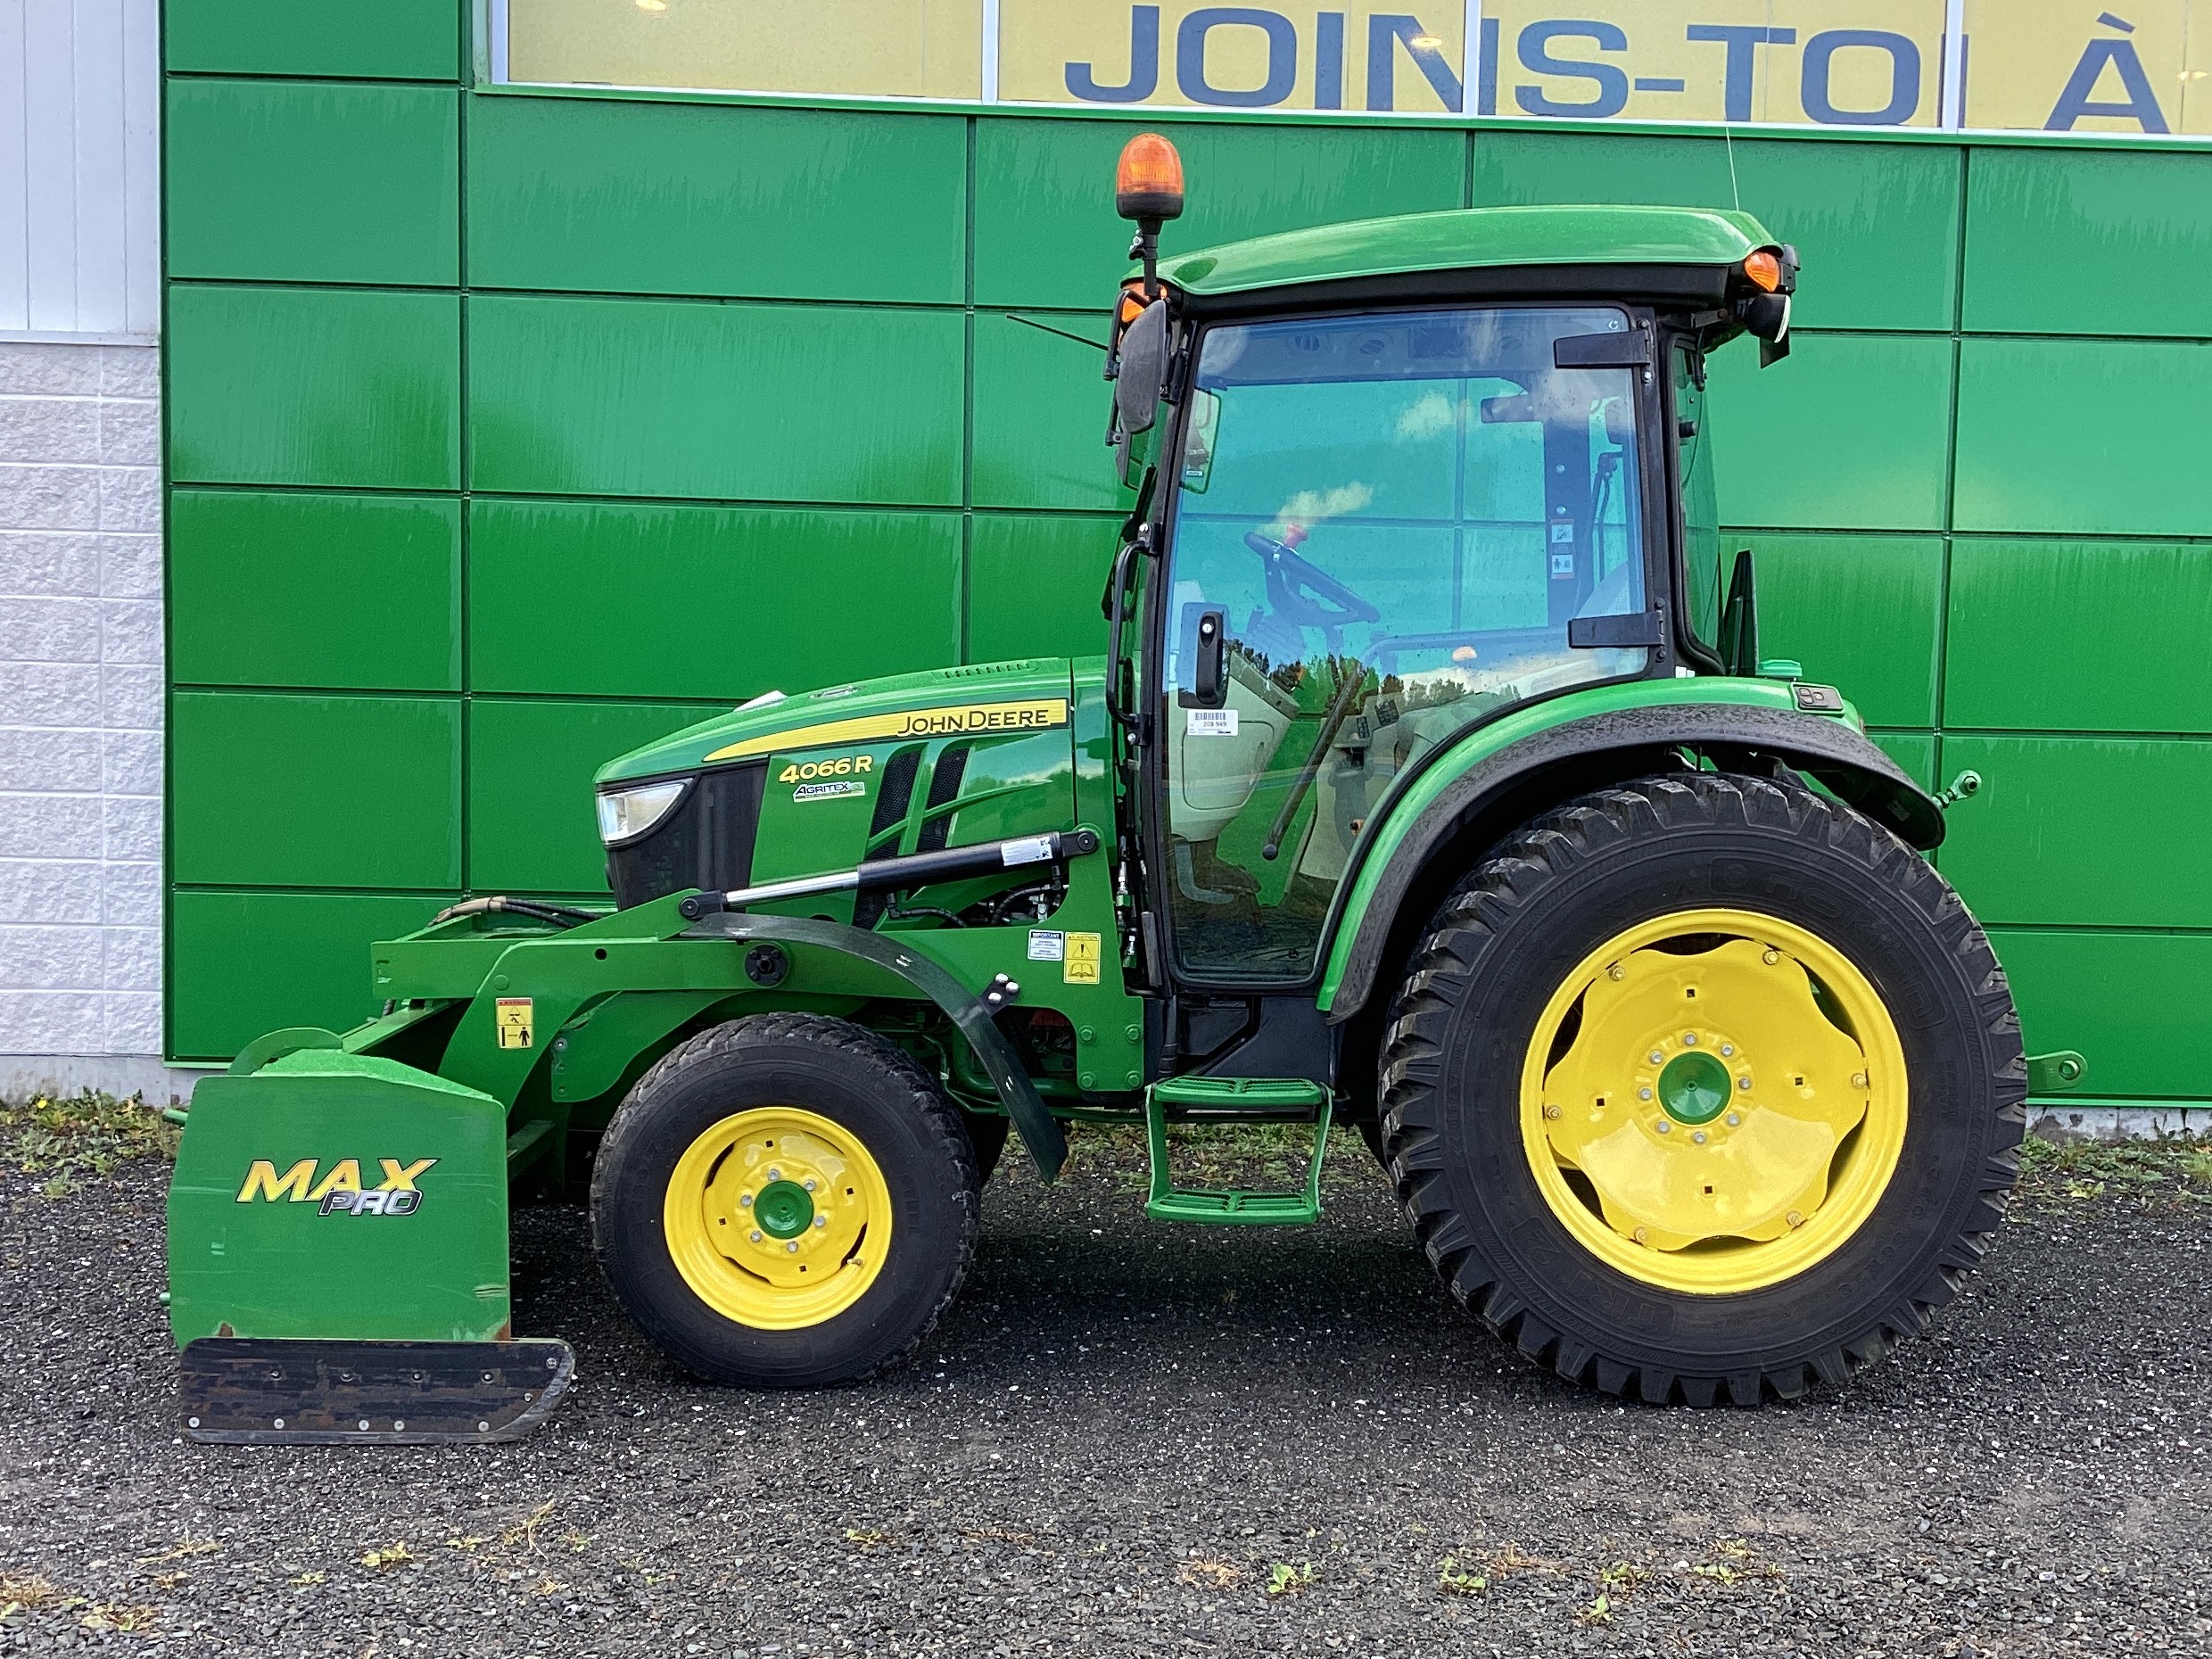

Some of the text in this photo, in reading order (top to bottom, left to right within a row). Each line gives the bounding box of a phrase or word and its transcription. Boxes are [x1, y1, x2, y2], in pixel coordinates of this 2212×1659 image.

[2043, 11, 2171, 134] À
[897, 709, 1049, 734] JOHN DEERE
[796, 783, 849, 796] AGRITEX
[235, 1158, 440, 1202] MAX
[318, 1189, 423, 1216] PRO
